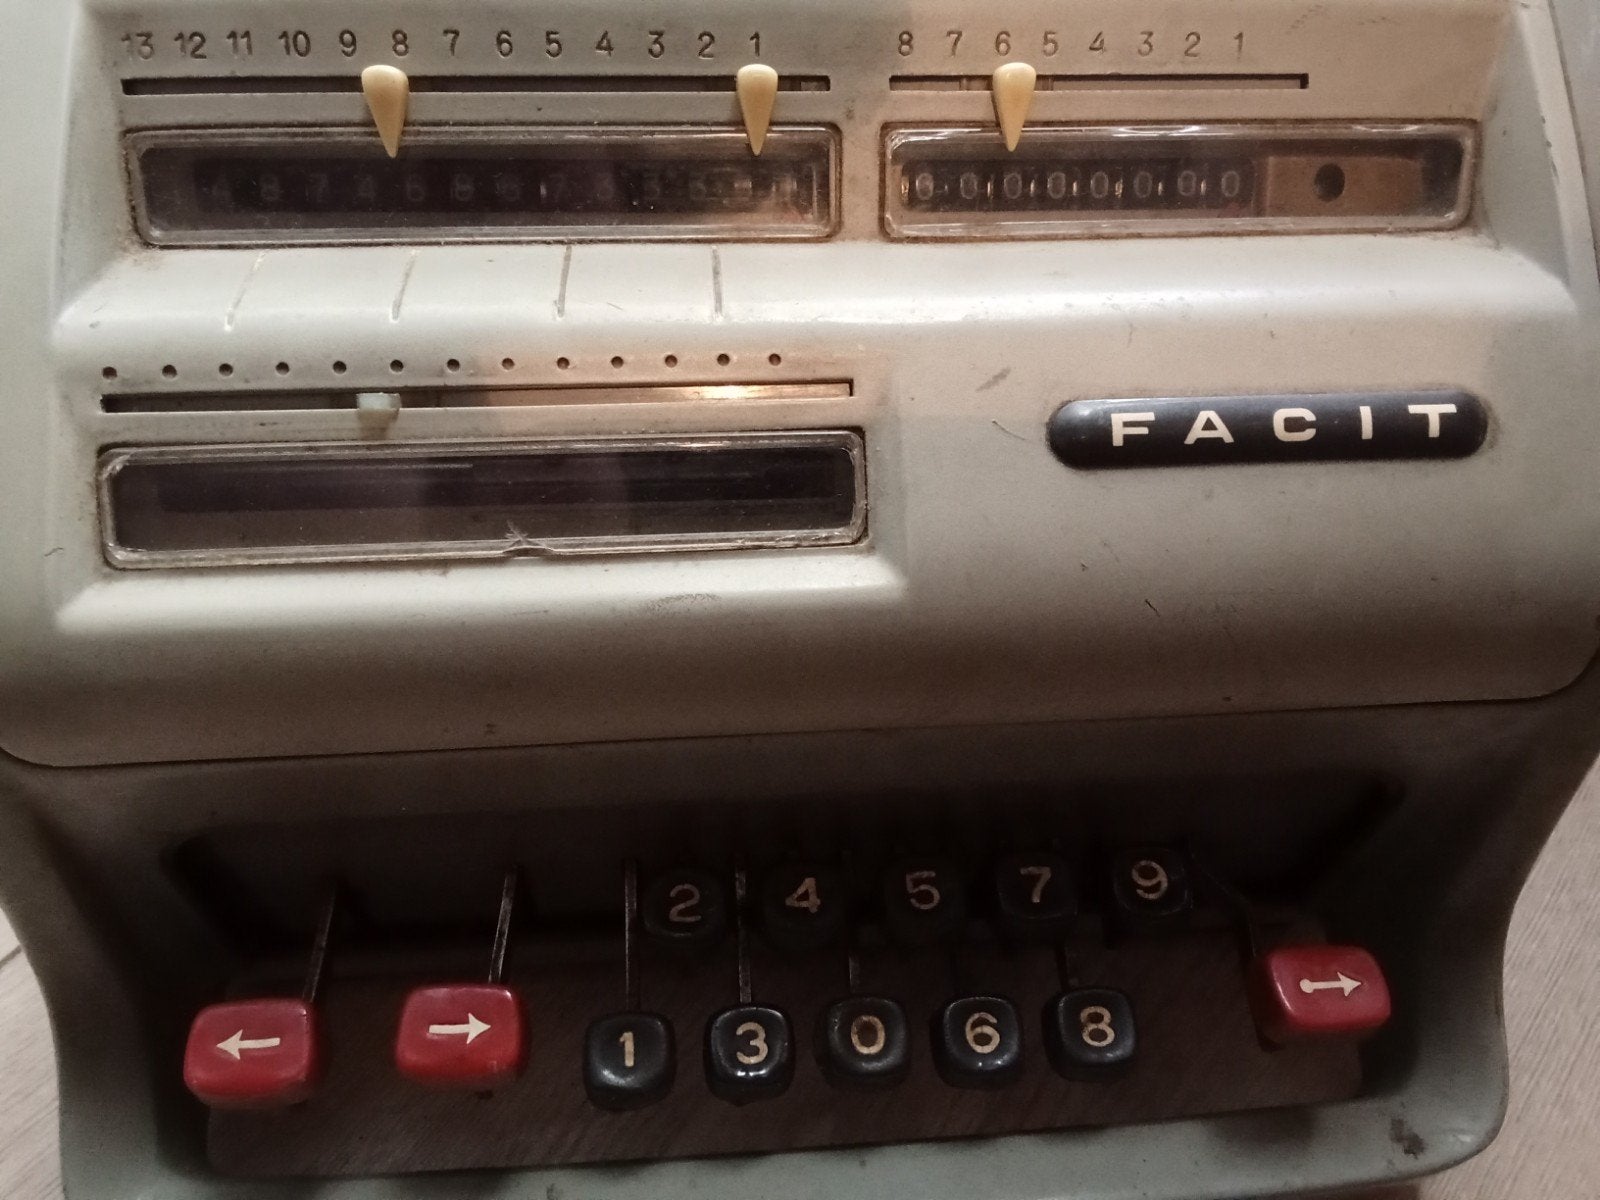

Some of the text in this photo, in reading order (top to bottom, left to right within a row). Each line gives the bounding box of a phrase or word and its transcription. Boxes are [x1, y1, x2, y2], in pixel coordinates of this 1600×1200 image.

[120, 29, 761, 60] 13 12 11 10 9 8 7 6 5 4 3 2 1
[896, 30, 1245, 58] 8 7 6 5 4 3 2 1
[1110, 403, 1458, 447] FACIT
[668, 860, 1168, 922] 2 4 5 7 9
[618, 1005, 1115, 1068] 1 3 0 6 8
